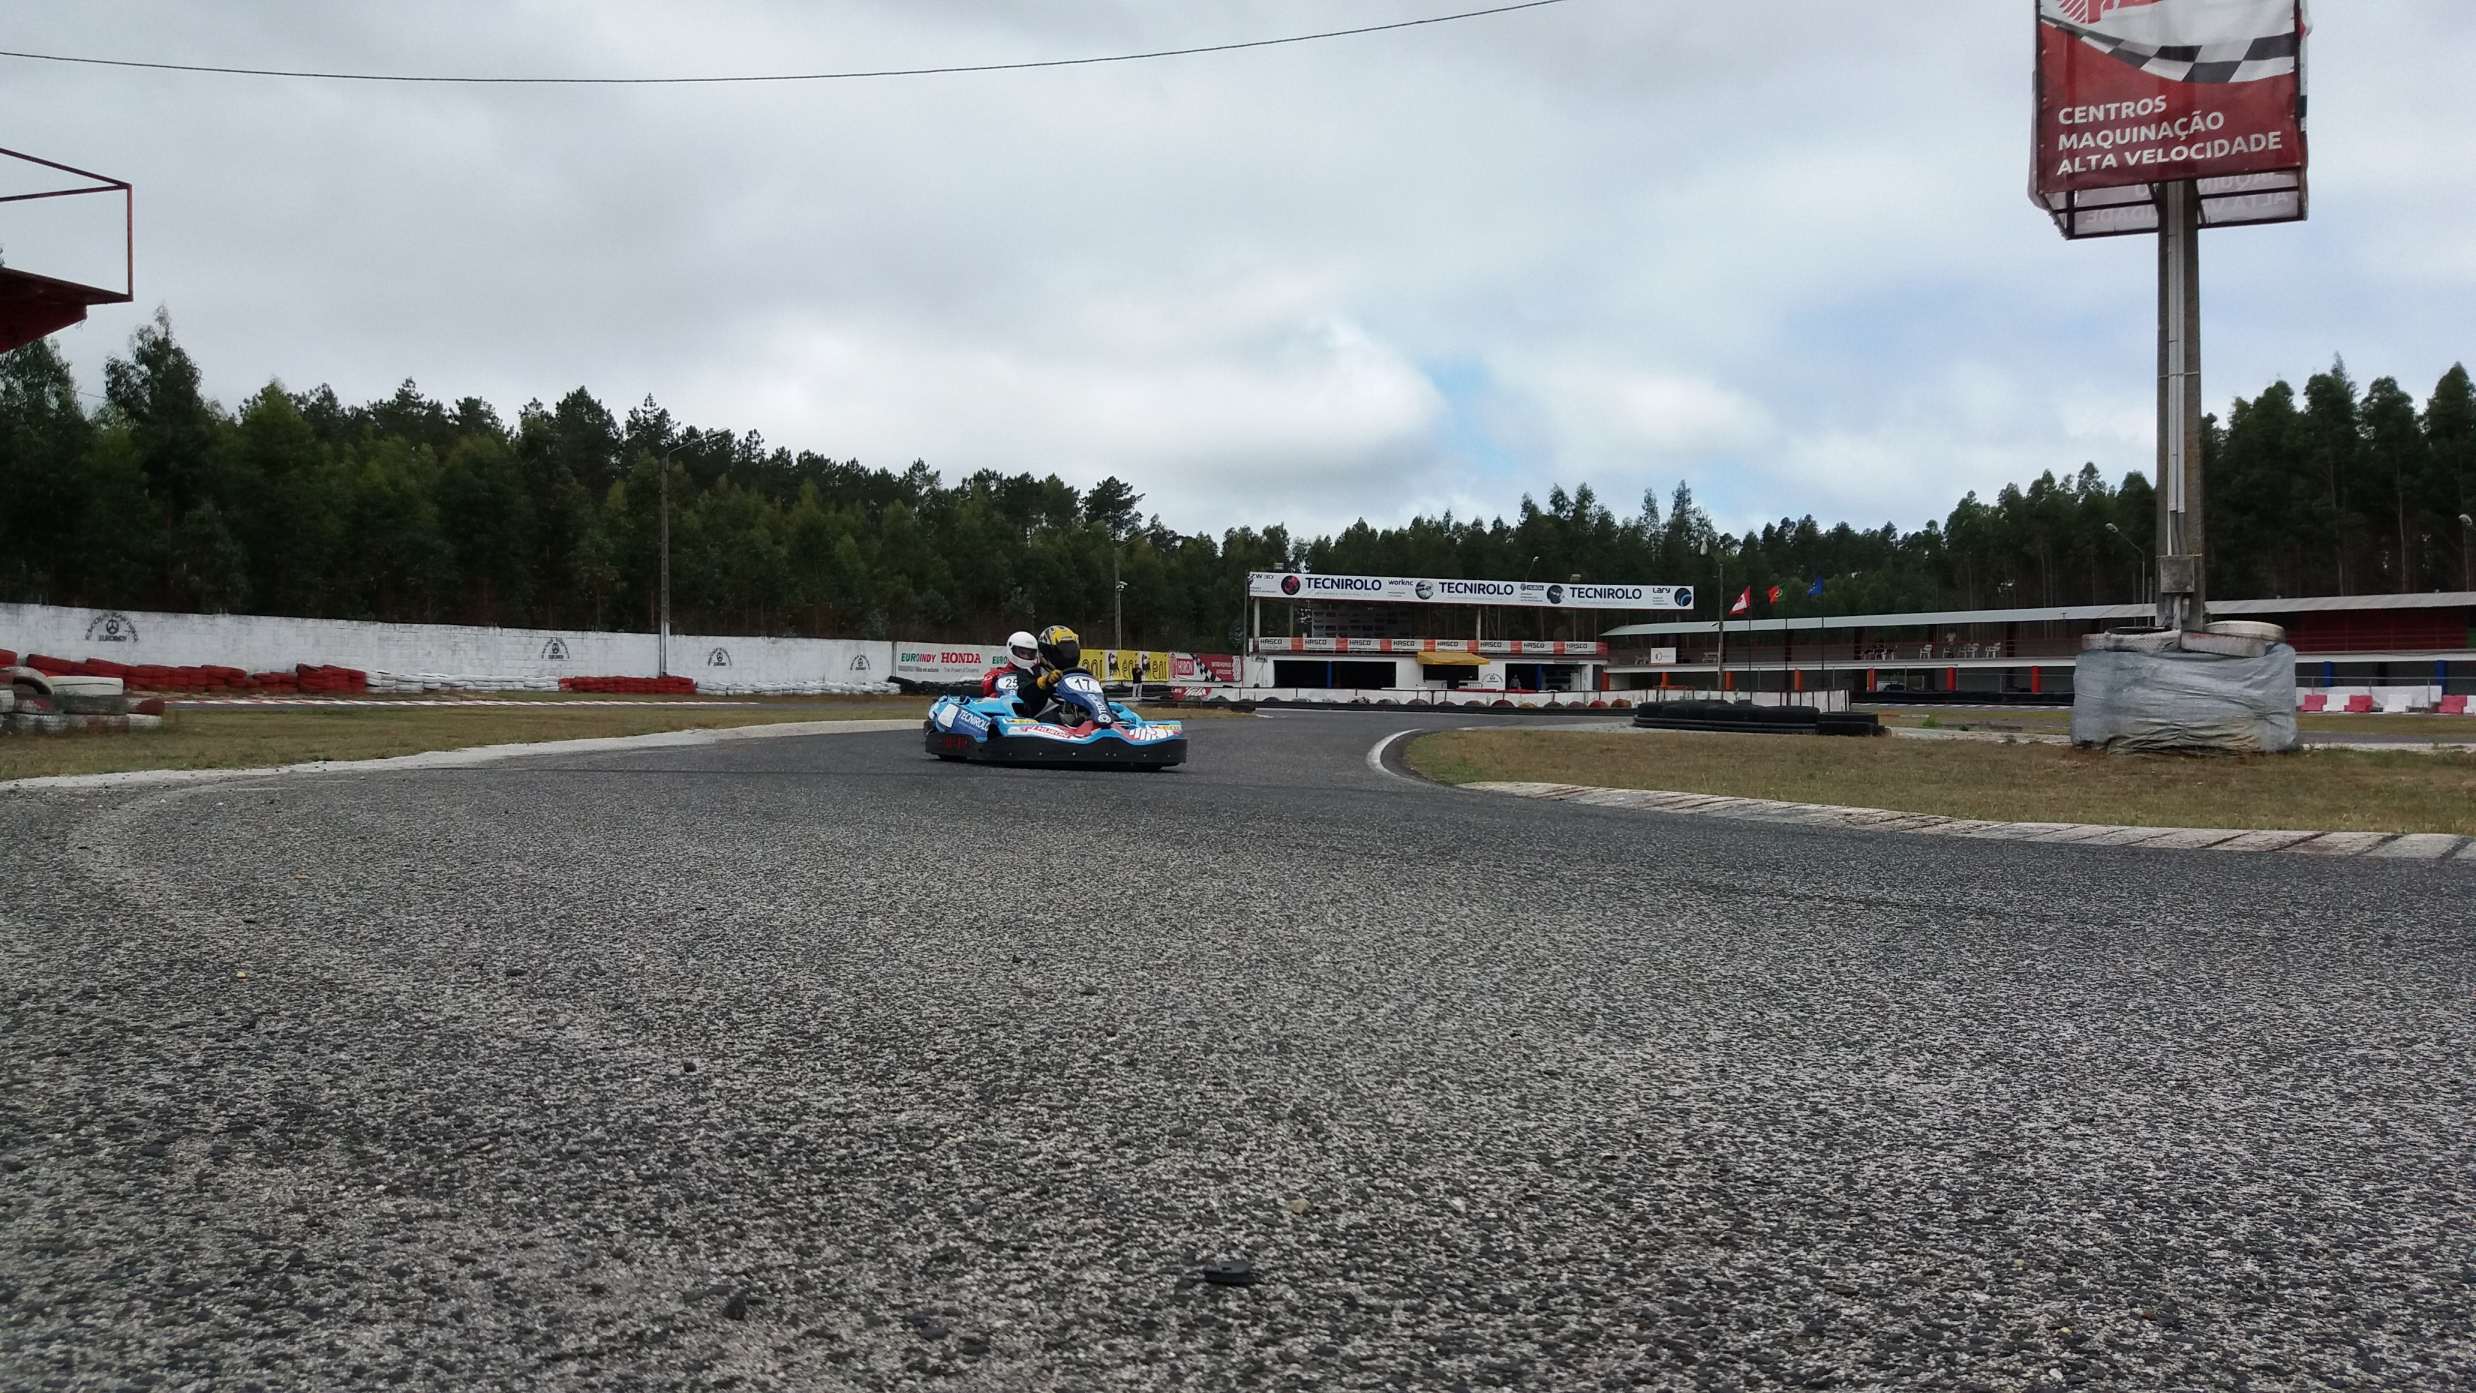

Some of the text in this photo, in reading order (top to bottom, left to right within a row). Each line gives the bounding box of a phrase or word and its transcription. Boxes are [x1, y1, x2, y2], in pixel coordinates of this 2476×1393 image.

[2058, 95, 2167, 125] CENTROS
[2057, 110, 2225, 151] MAQUINAÇÃO
[2056, 131, 2283, 177] ALTA VELOCIDADE
[1305, 577, 1382, 591] TECNIROLO
[1439, 582, 1514, 596] TECNIROLO
[1569, 587, 1642, 600] TECNIROLO
[901, 652, 982, 664] EUROINDY HONDA
[992, 656, 1008, 664] EURO
[1153, 654, 1167, 679] eni
[1006, 678, 1018, 688] 25
[1075, 678, 1090, 690] 17
[959, 710, 991, 732] TECNIROLO
